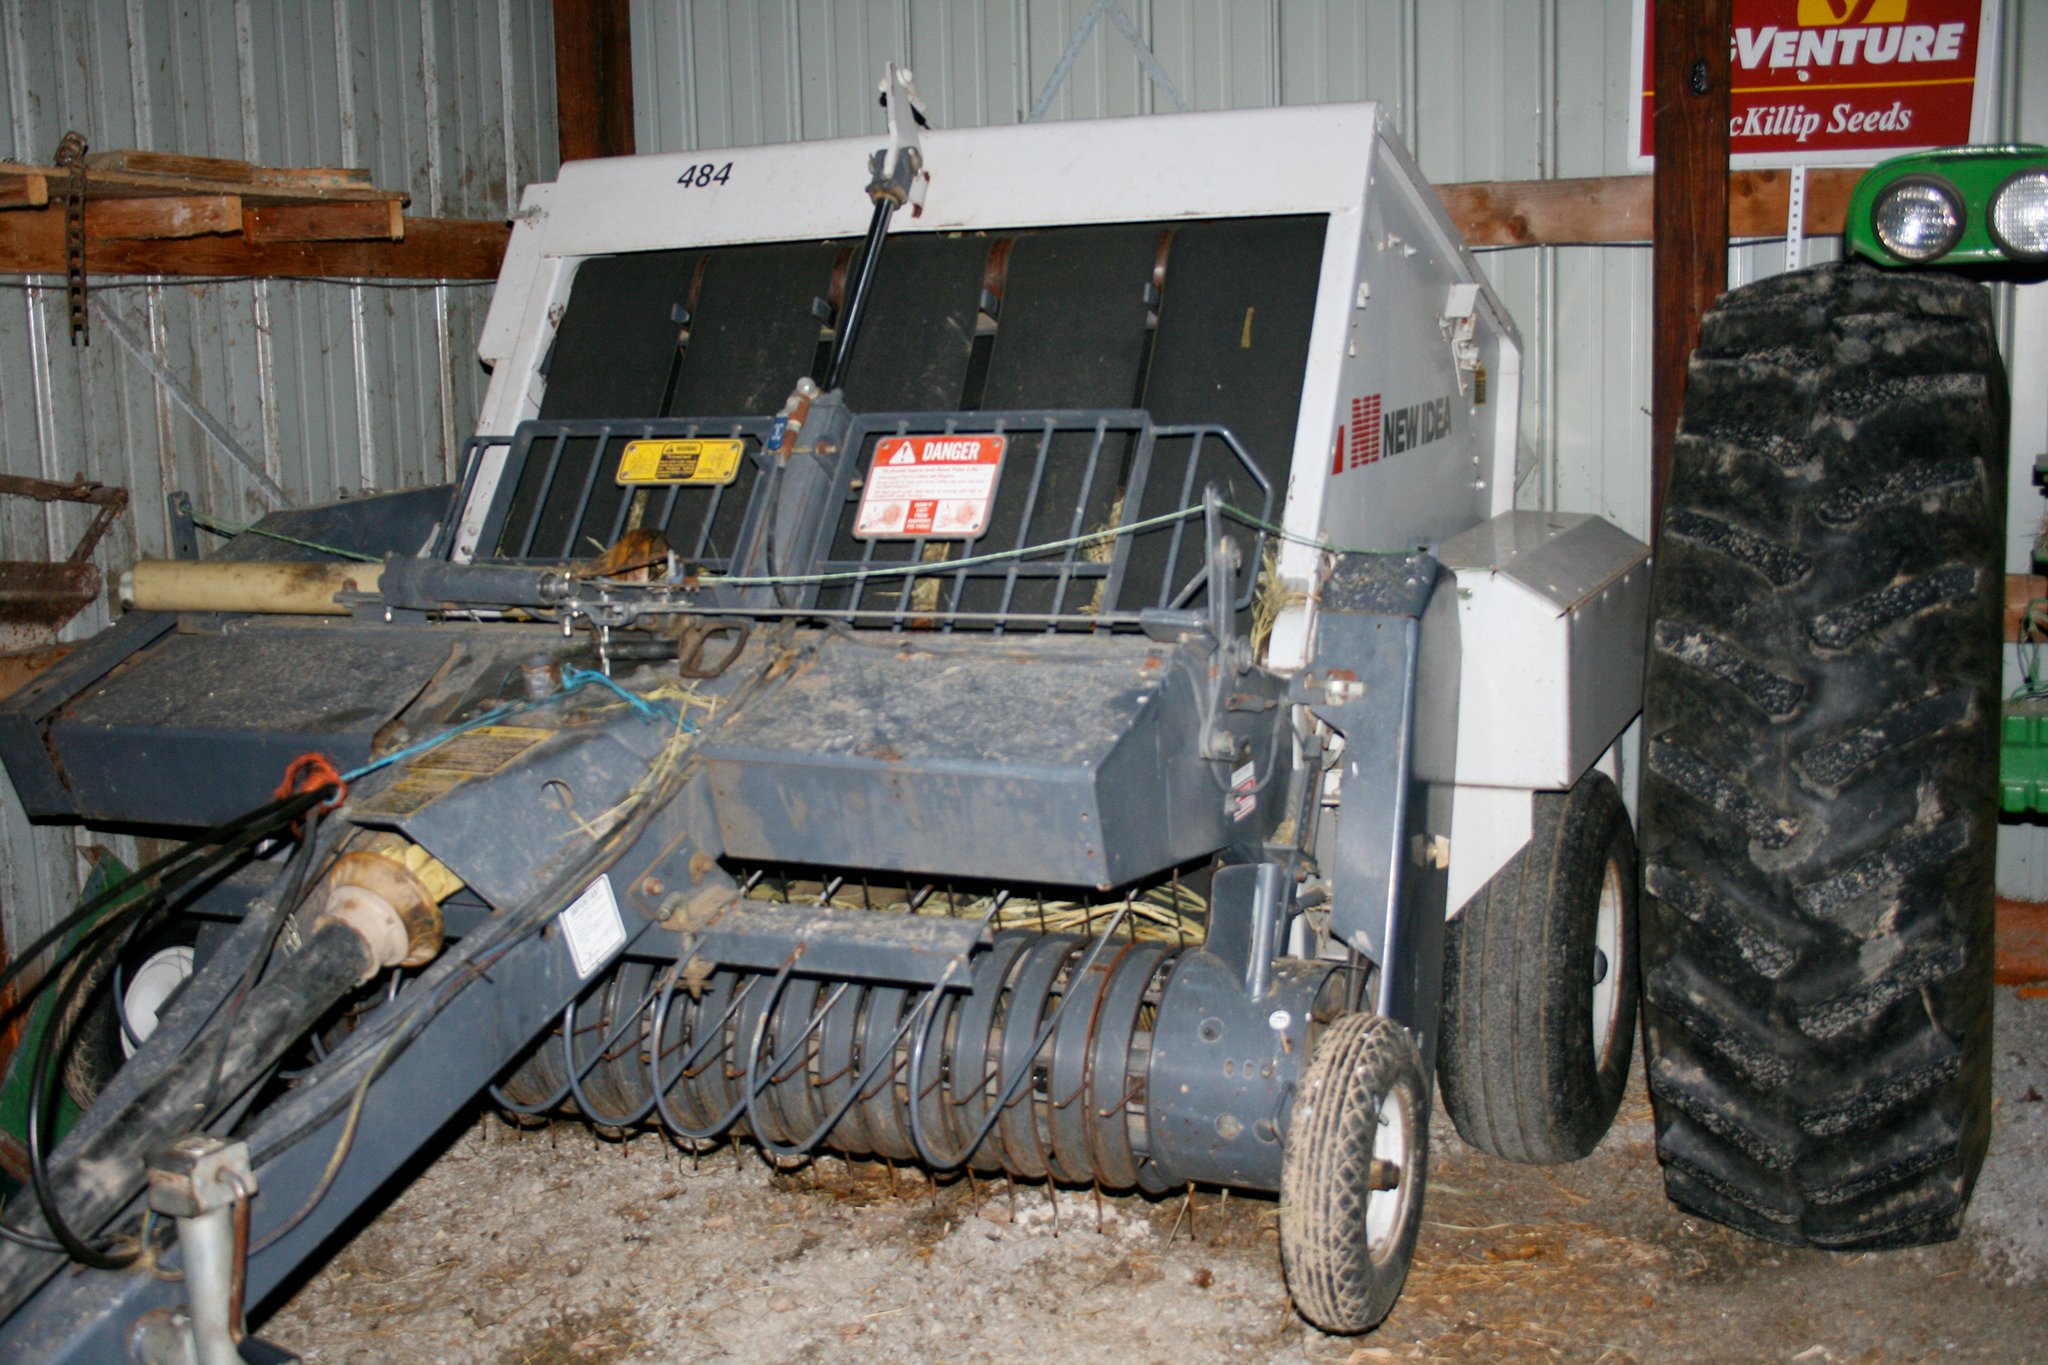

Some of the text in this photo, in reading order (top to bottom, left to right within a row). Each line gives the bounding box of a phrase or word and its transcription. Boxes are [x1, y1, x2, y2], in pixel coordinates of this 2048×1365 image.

[1826, 101, 1912, 133] Seeds
[677, 162, 734, 188] 484
[1383, 395, 1453, 458] NEW IDEA
[921, 441, 981, 462] DANGER
